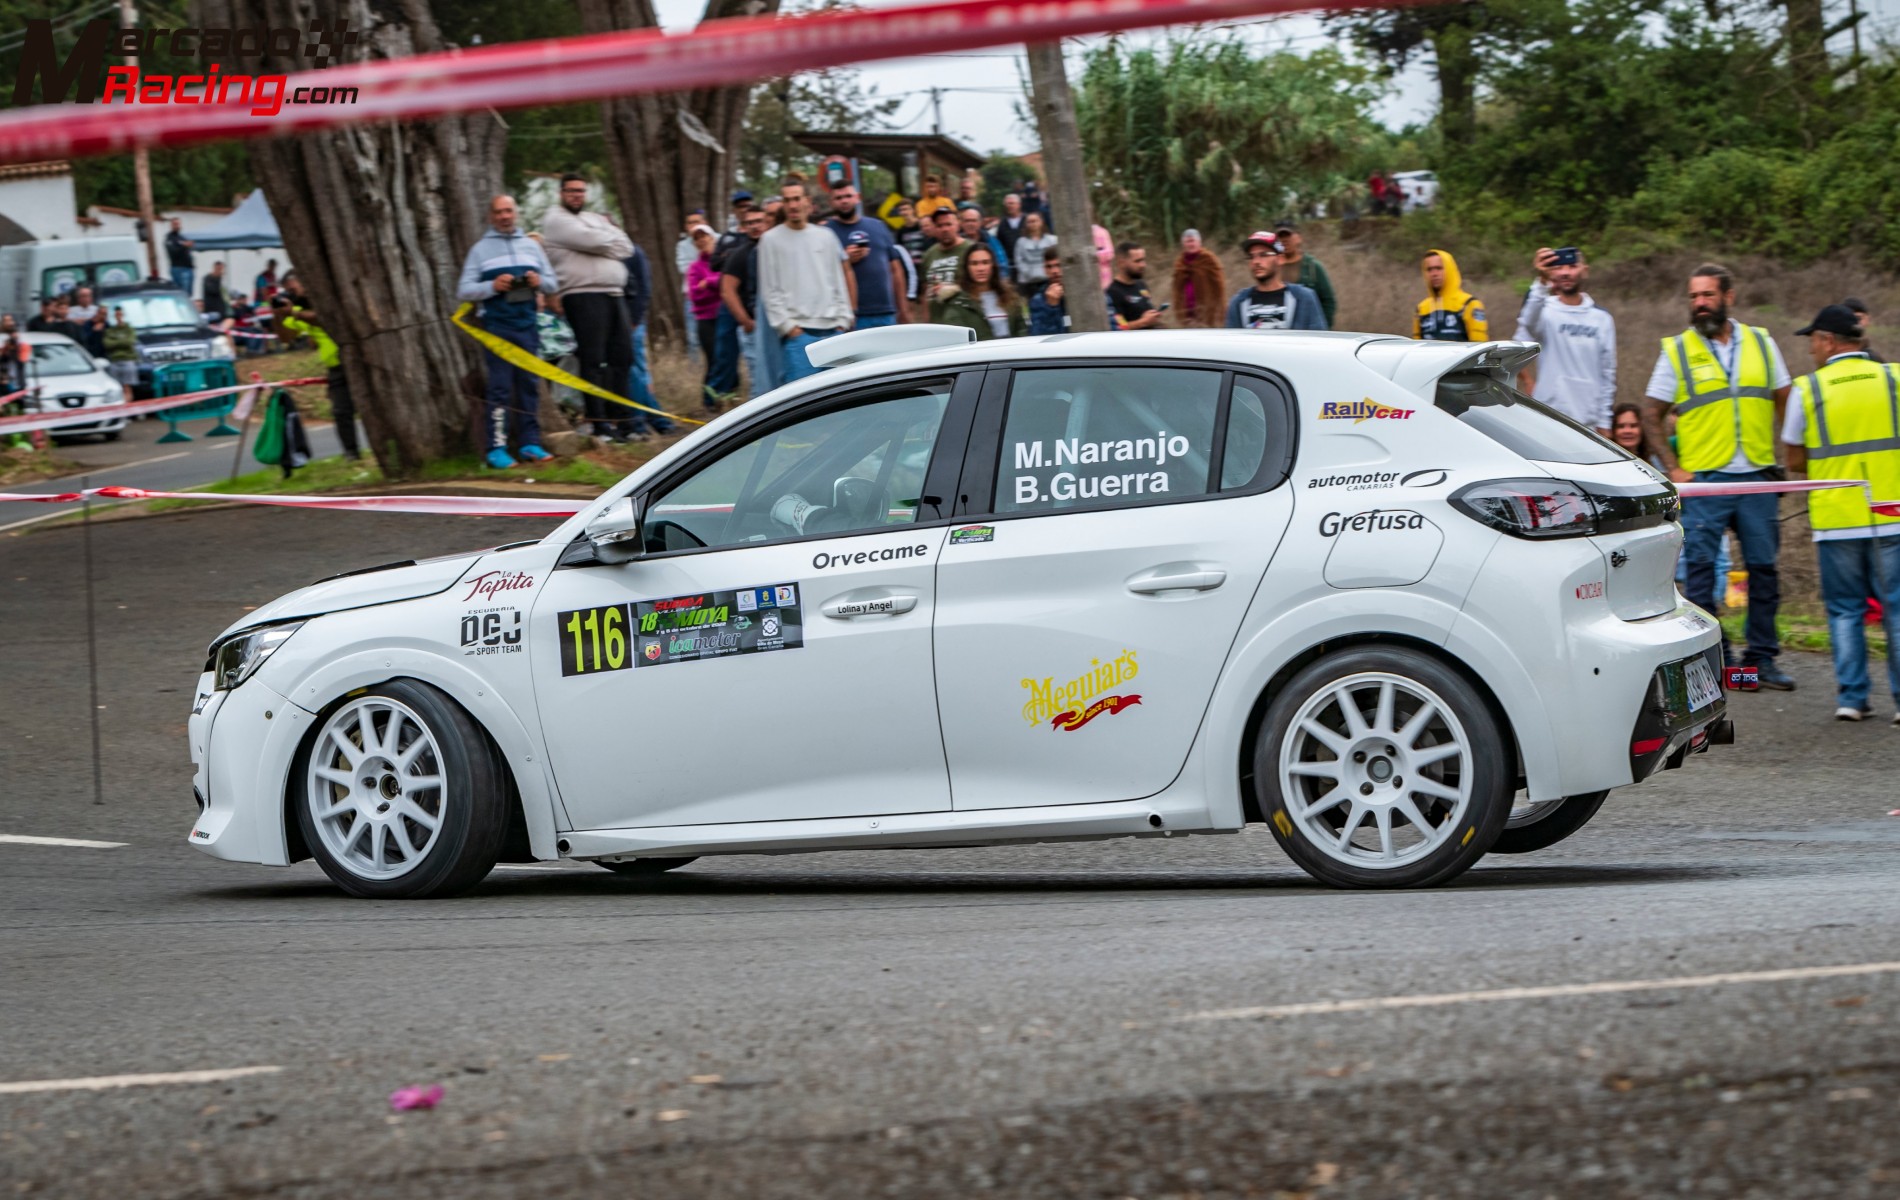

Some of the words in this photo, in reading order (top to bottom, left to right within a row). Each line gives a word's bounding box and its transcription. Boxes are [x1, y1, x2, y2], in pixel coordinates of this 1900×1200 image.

[1015, 431, 1190, 469] M.Naranjo
[1015, 471, 1170, 504] B.Guerra
[1308, 472, 1400, 489] automotor
[1346, 482, 1394, 491] CANARIAS
[1319, 511, 1424, 537] Grefusa
[812, 544, 928, 569] Orvecame
[462, 570, 534, 601] Tapita
[468, 606, 515, 614] ESCUDERIA
[640, 612, 658, 632] 18
[678, 606, 728, 627] MOYA
[838, 605, 860, 613] Lolina
[862, 605, 867, 614] y
[869, 600, 893, 612] Angel
[461, 611, 521, 647] DGJ
[567, 607, 625, 673] 116
[477, 646, 499, 656] SPORT
[502, 645, 522, 654] TEAM
[669, 632, 741, 654] icamotor
[1021, 648, 1139, 728] Meguiar's
